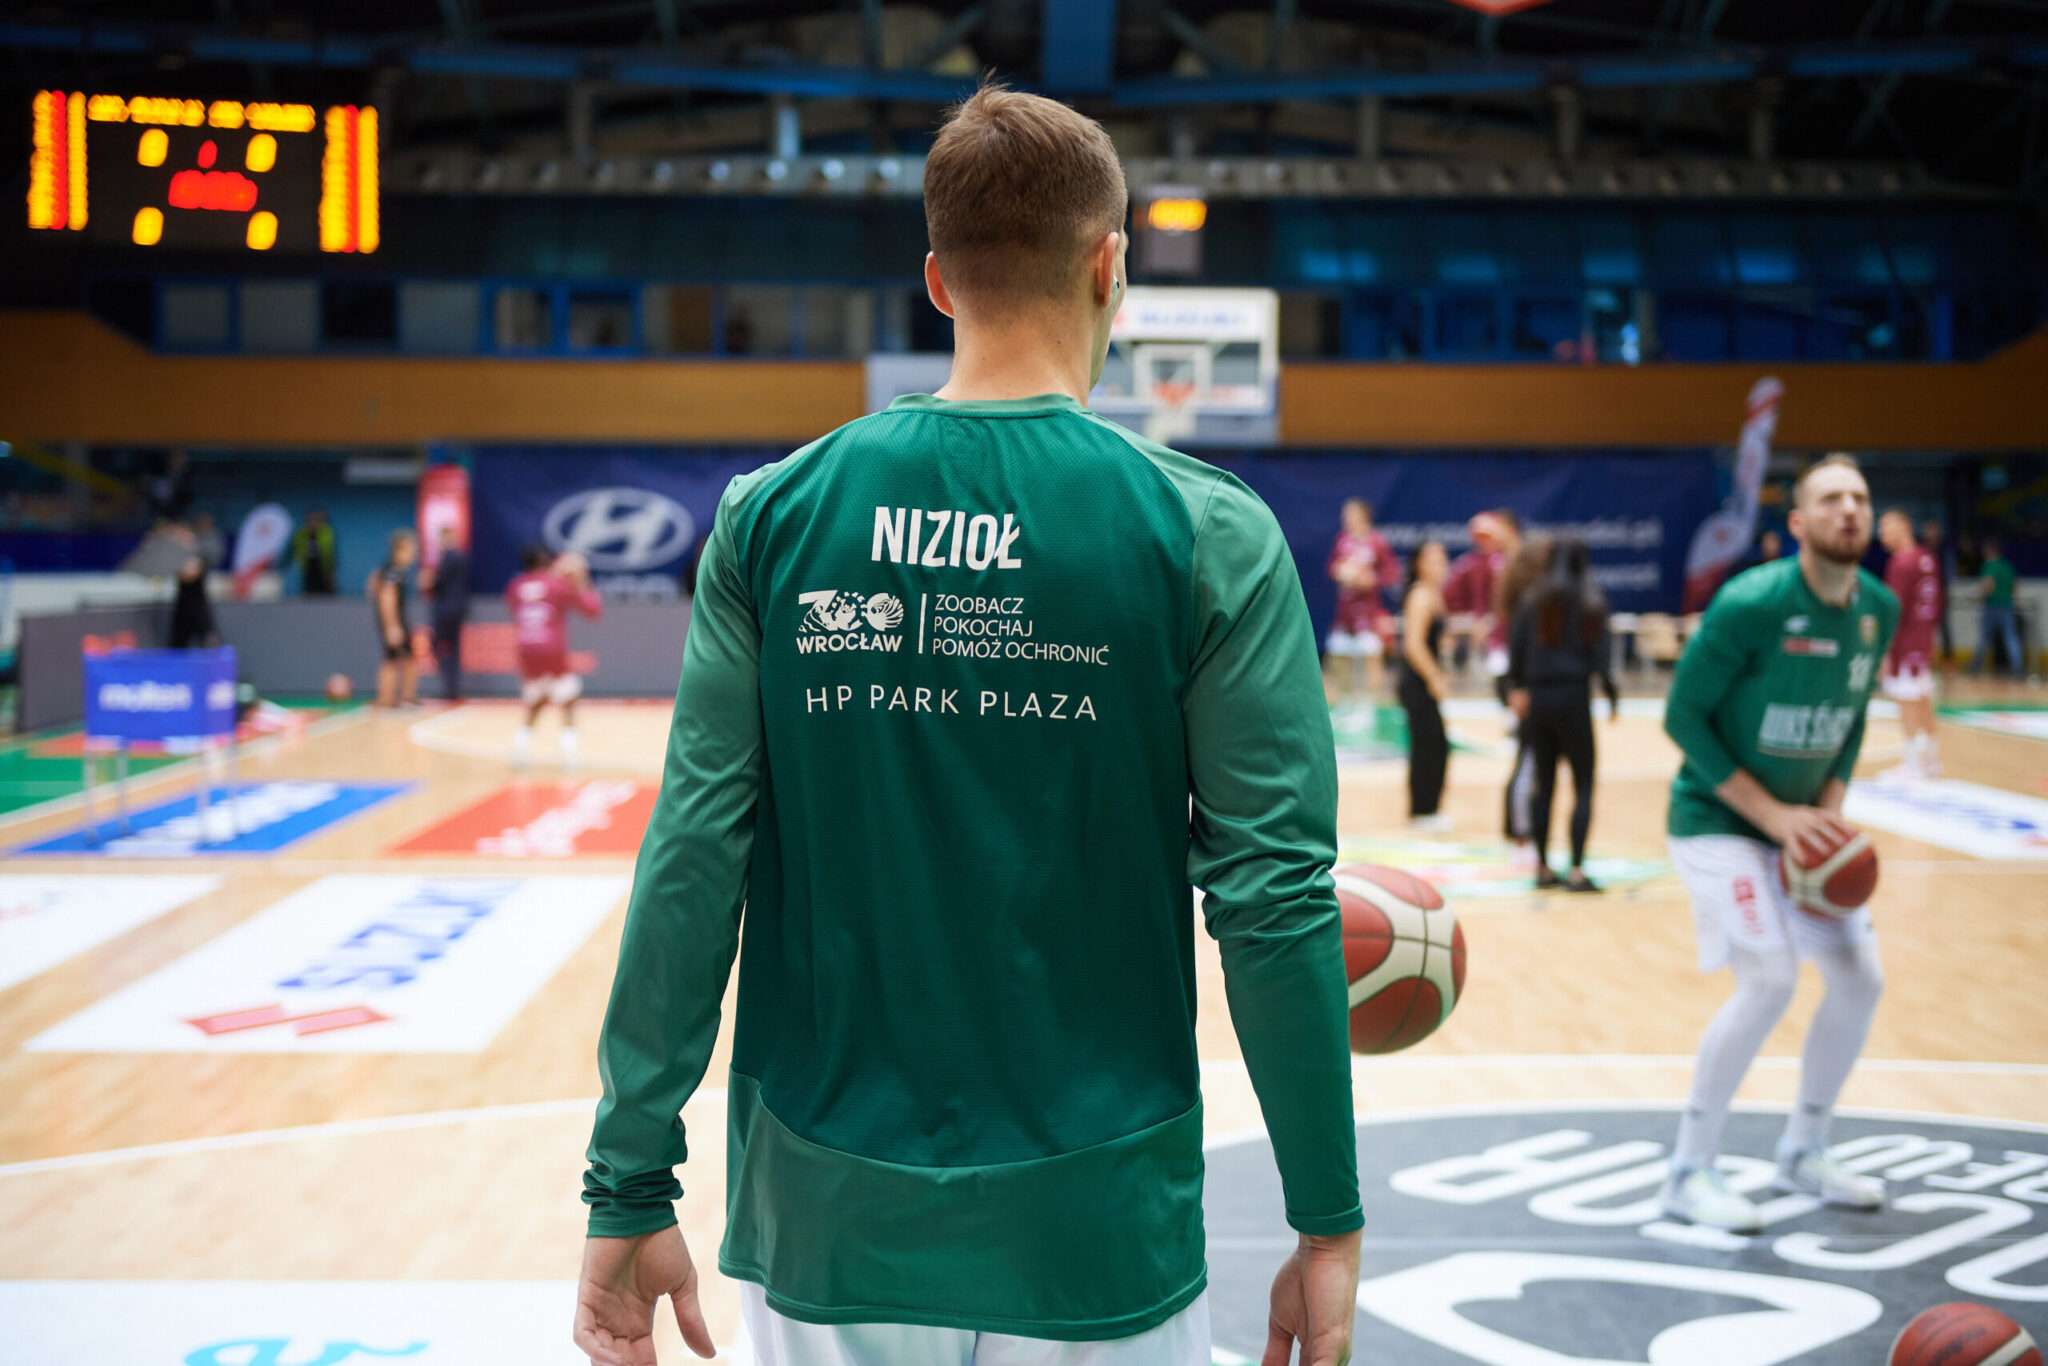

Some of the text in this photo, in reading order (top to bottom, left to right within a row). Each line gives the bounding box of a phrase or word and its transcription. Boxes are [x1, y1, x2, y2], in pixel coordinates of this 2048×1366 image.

[871, 506, 1022, 571] NIZIOŁ
[934, 593, 1025, 615] ZOOBACZ
[933, 615, 1033, 637] POKOCHAJ
[795, 632, 903, 655] WROCŁAW
[932, 638, 1110, 666] POMÓŻ OCHRONIĆ
[806, 684, 1097, 721] HP PARK PLAZA
